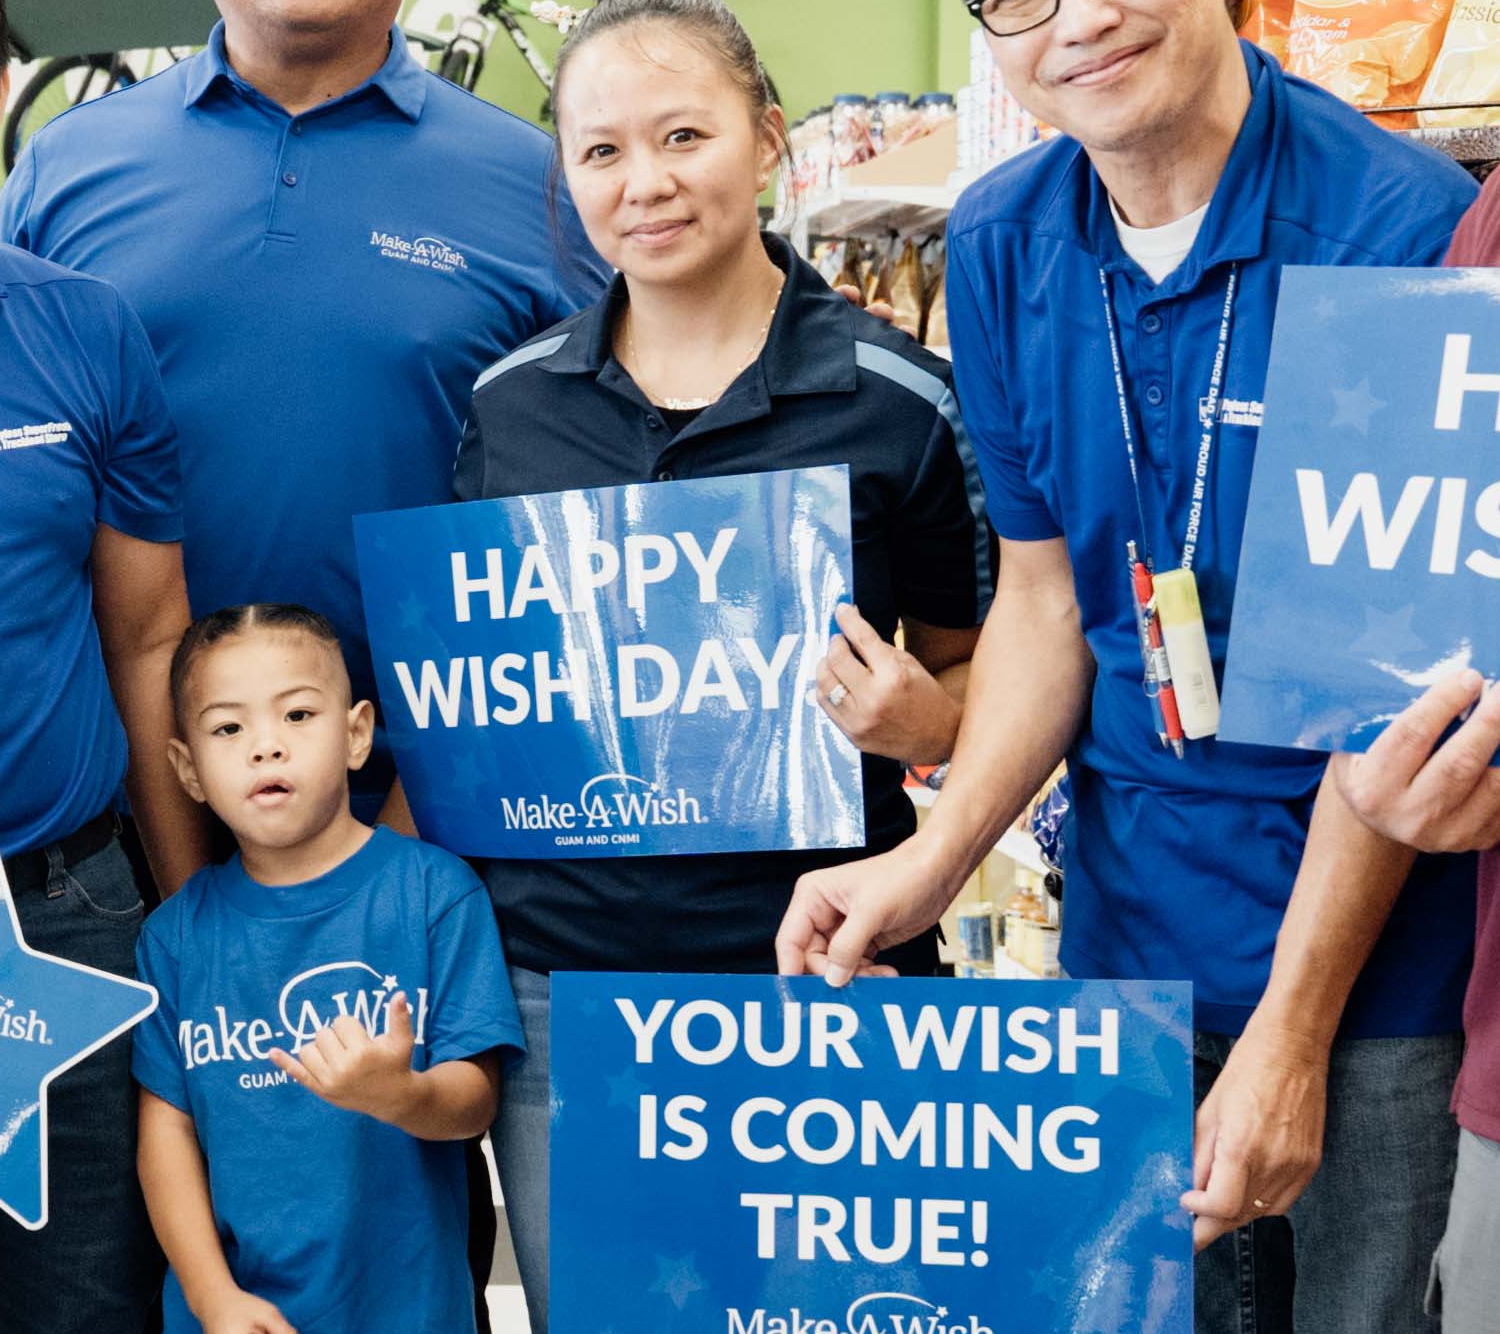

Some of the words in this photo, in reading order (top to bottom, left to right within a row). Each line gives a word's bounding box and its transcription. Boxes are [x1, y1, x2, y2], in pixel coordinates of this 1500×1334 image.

[370, 231, 467, 269] Make-A-Wish
[1196, 434, 1211, 477] PROUD
[1192, 477, 1204, 501] AIR
[1186, 501, 1201, 543] FORCE
[451, 527, 738, 623] HAPPY
[394, 648, 592, 730] WISH
[617, 633, 817, 719] DAY
[502, 775, 708, 830] Make-A-Wish
[555, 835, 583, 847] GUAM
[585, 835, 608, 846] AND
[610, 834, 640, 845] CNMI
[614, 998, 860, 1069] YOUR
[883, 1004, 1119, 1076] WISH
[239, 1071, 288, 1091] GUAM
[639, 1093, 709, 1161] IS
[730, 1095, 1101, 1174] COMING
[740, 1192, 990, 1268] TRUE!
